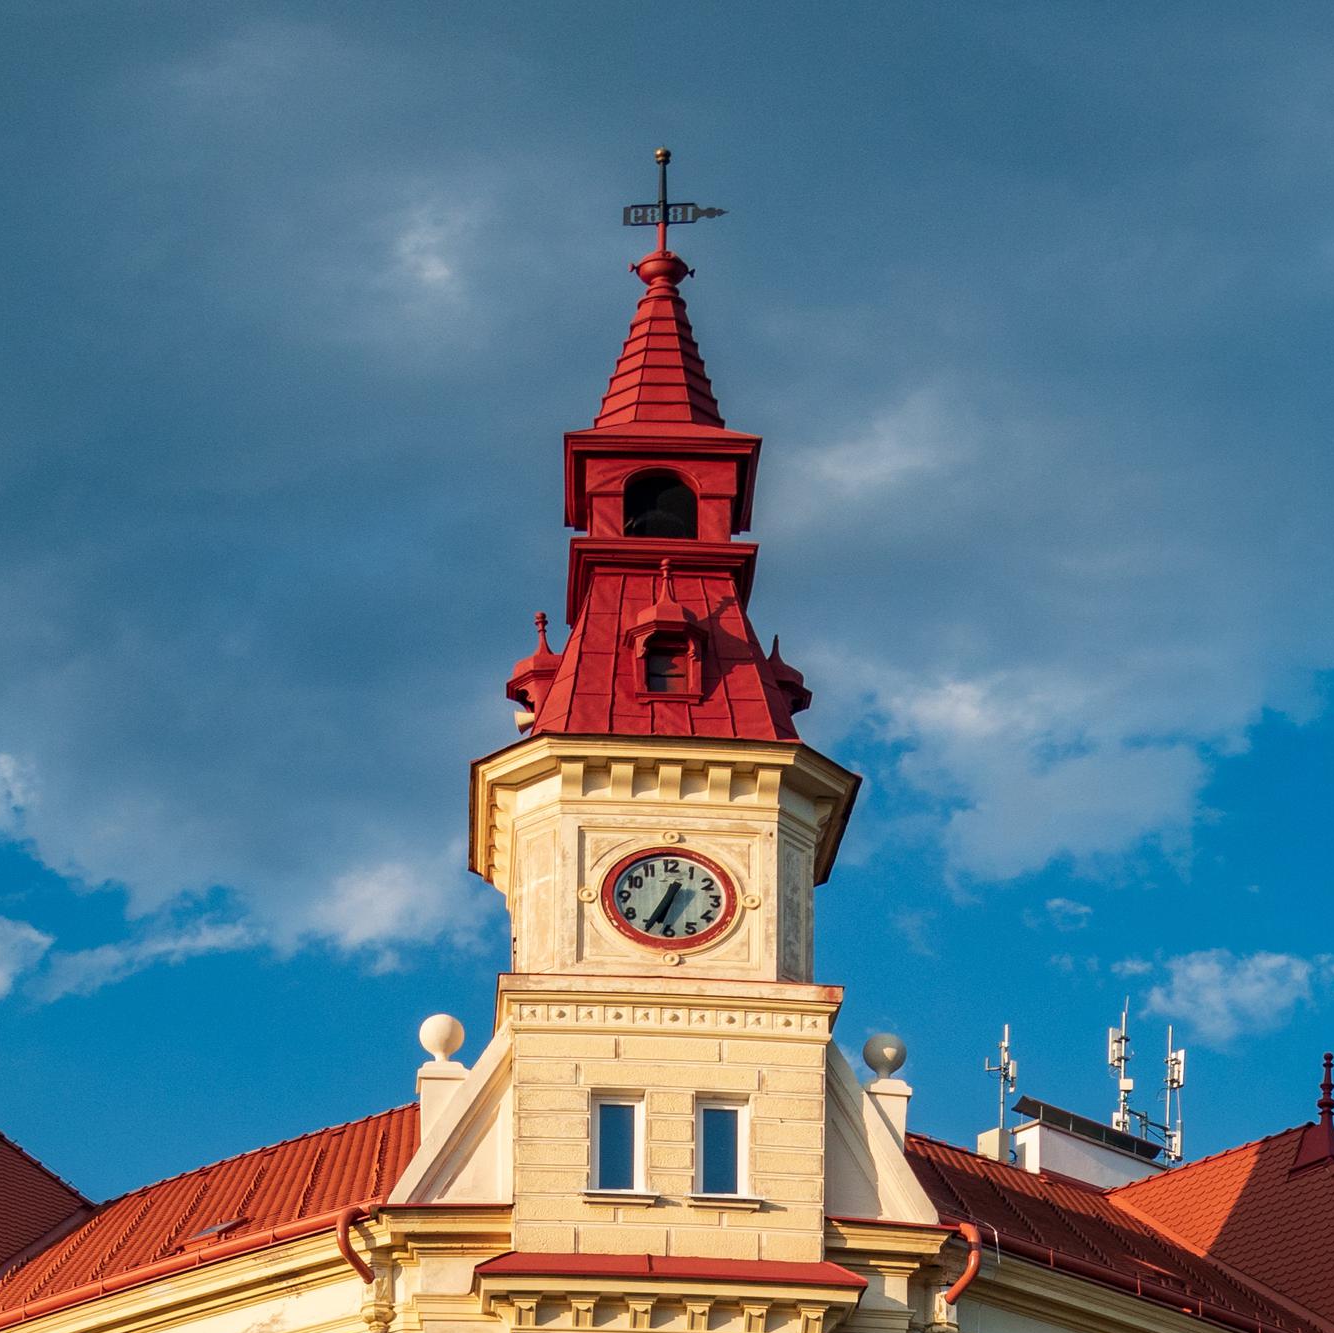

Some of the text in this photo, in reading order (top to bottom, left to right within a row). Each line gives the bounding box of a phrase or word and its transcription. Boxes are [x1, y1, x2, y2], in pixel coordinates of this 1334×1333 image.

[643, 864, 655, 877] 11
[663, 859, 680, 874] 12
[689, 867, 695, 880] 1
[628, 874, 643, 889] 10
[701, 878, 715, 891] 2
[618, 890, 632, 903] 9
[709, 895, 722, 908] 3
[624, 907, 637, 920] 8
[700, 909, 714, 923] 4
[662, 925, 676, 938] 6
[685, 921, 698, 935] 5
